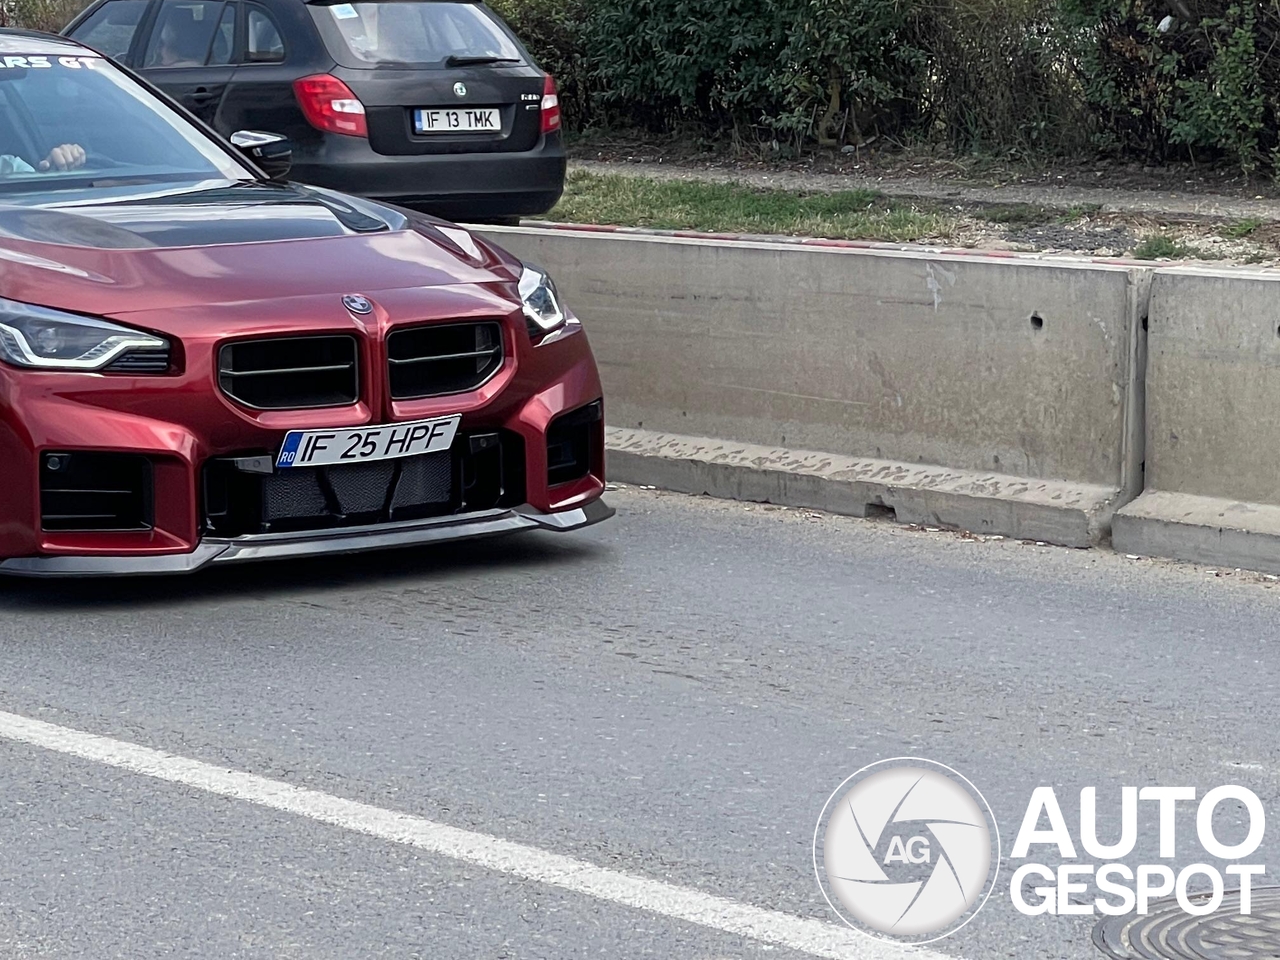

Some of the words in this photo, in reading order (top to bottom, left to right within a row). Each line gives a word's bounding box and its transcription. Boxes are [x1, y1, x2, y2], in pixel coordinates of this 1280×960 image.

[58, 56, 96, 70] GT
[427, 111, 440, 128] IF
[446, 111, 460, 128] 13
[465, 111, 494, 128] TMK
[279, 451, 295, 463] RO
[300, 434, 336, 462] IF
[340, 431, 380, 459] 25
[384, 420, 452, 455] HPF
